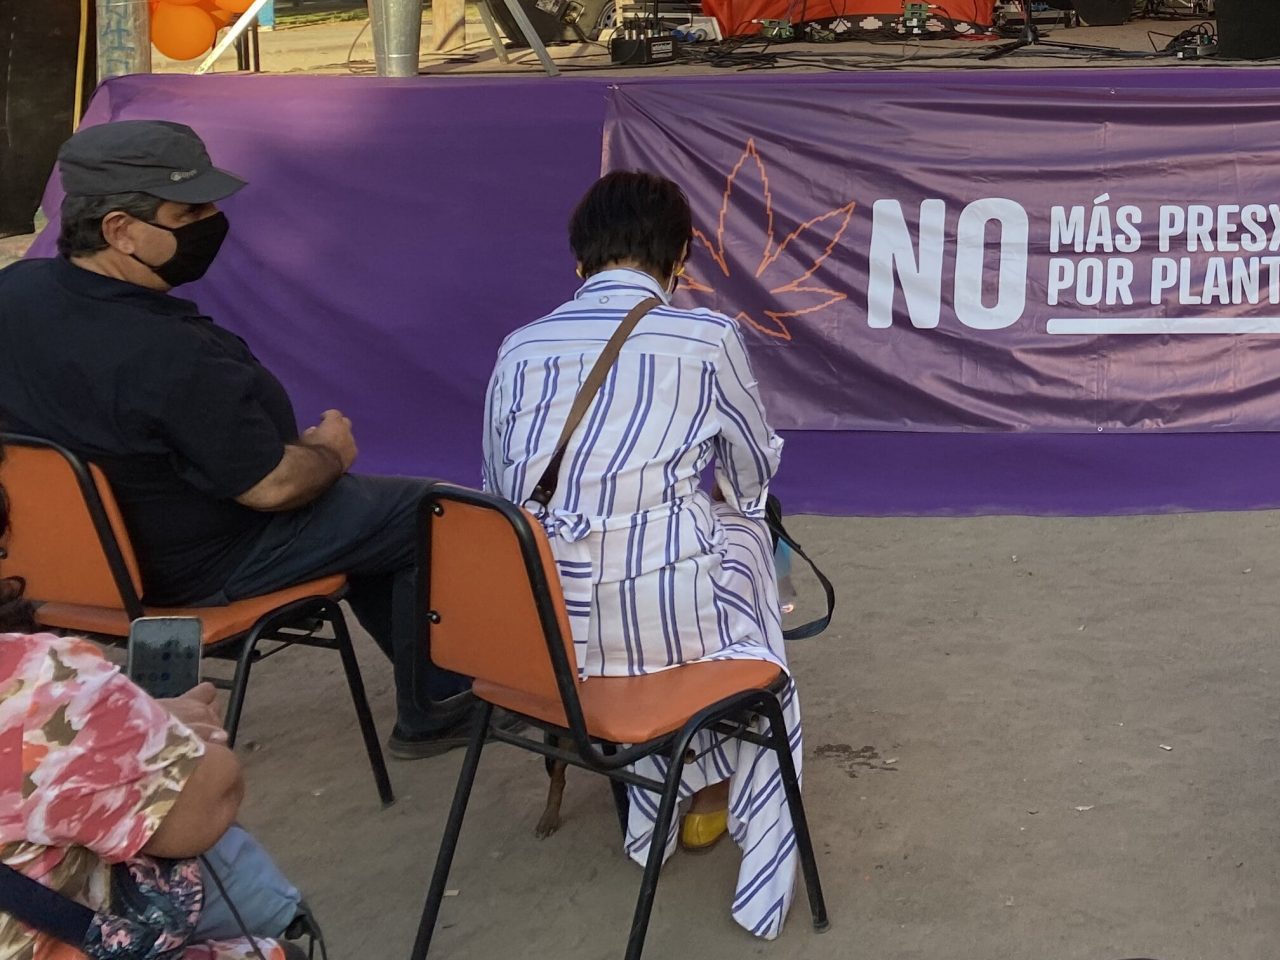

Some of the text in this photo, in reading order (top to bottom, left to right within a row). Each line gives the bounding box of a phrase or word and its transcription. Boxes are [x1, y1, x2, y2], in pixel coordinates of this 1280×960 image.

[1049, 192, 1143, 253] MÁS
[867, 197, 1030, 330] NO
[1047, 257, 1134, 306] POR
